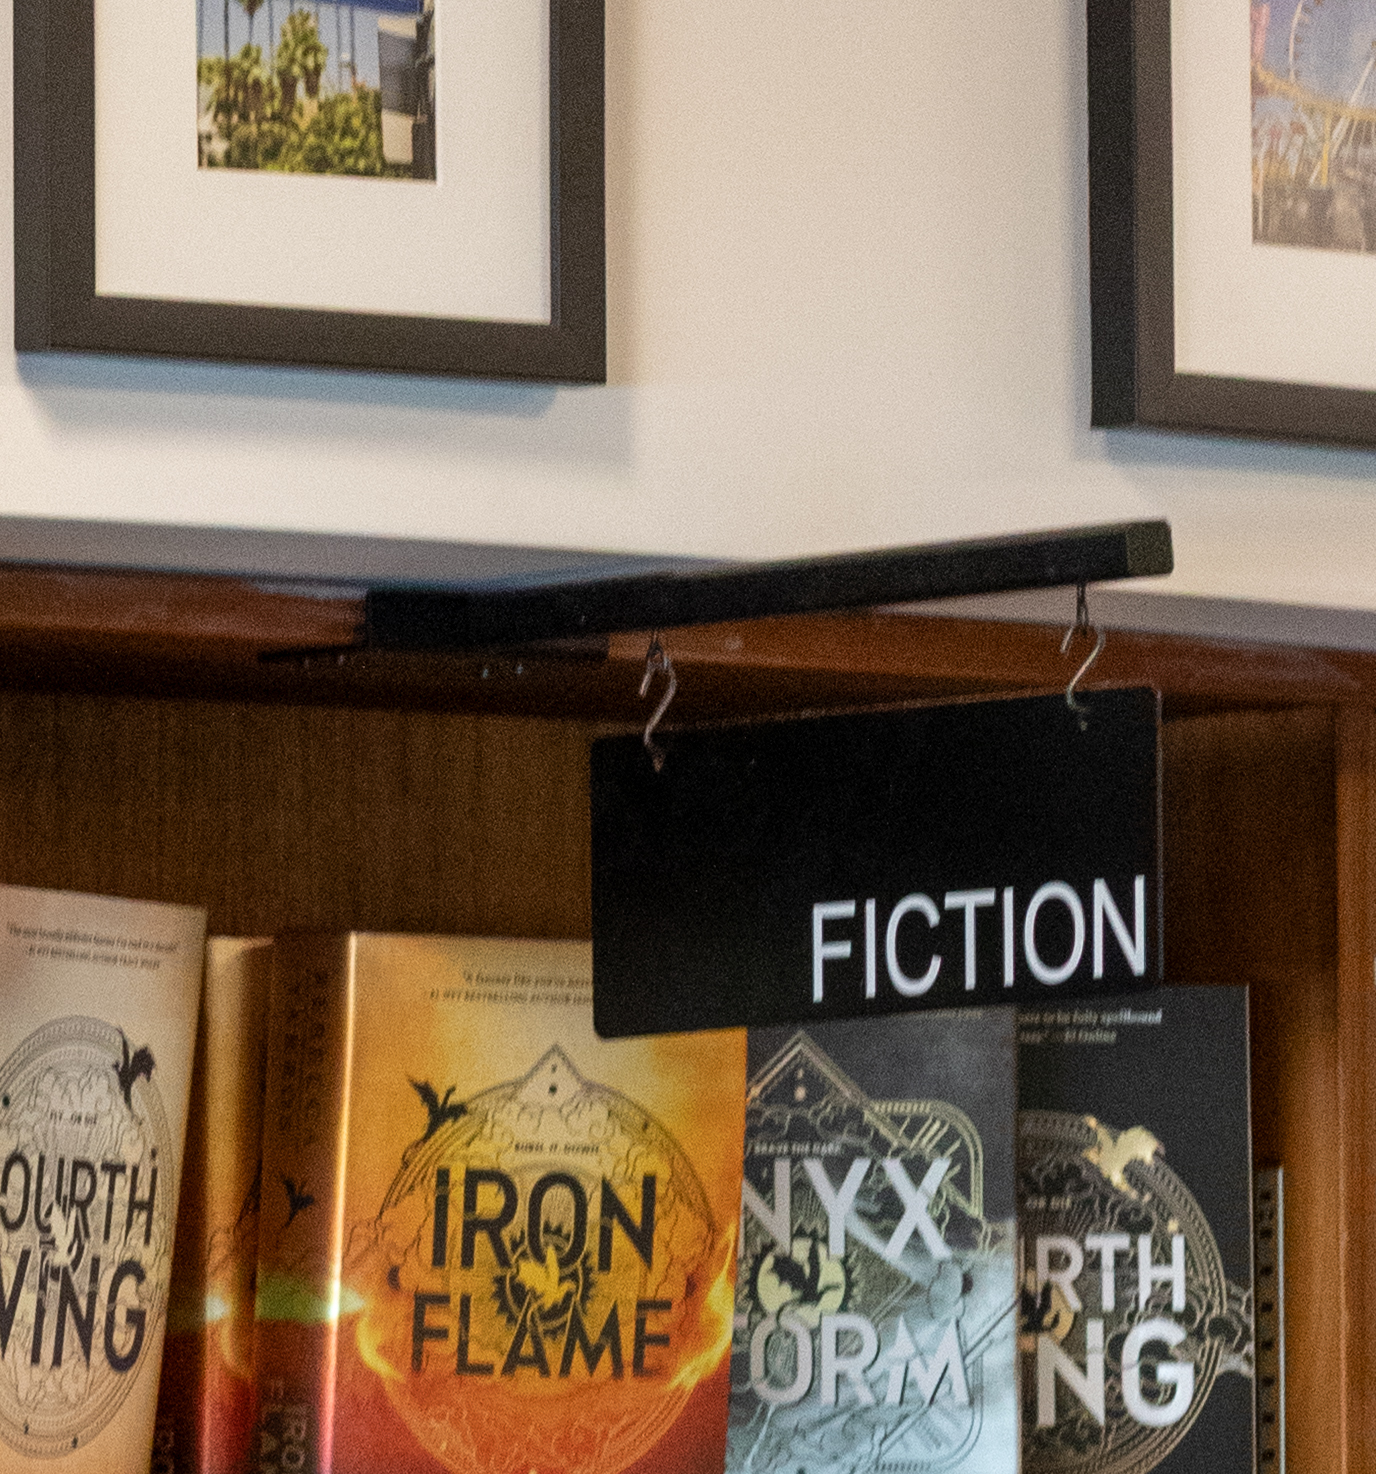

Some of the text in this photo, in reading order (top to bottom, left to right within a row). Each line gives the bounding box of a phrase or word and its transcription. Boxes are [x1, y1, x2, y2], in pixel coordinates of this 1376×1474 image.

[813, 875, 1145, 1003] FICTION
[428, 1166, 659, 1274] IRON
[410, 1291, 673, 1381] FLAME
